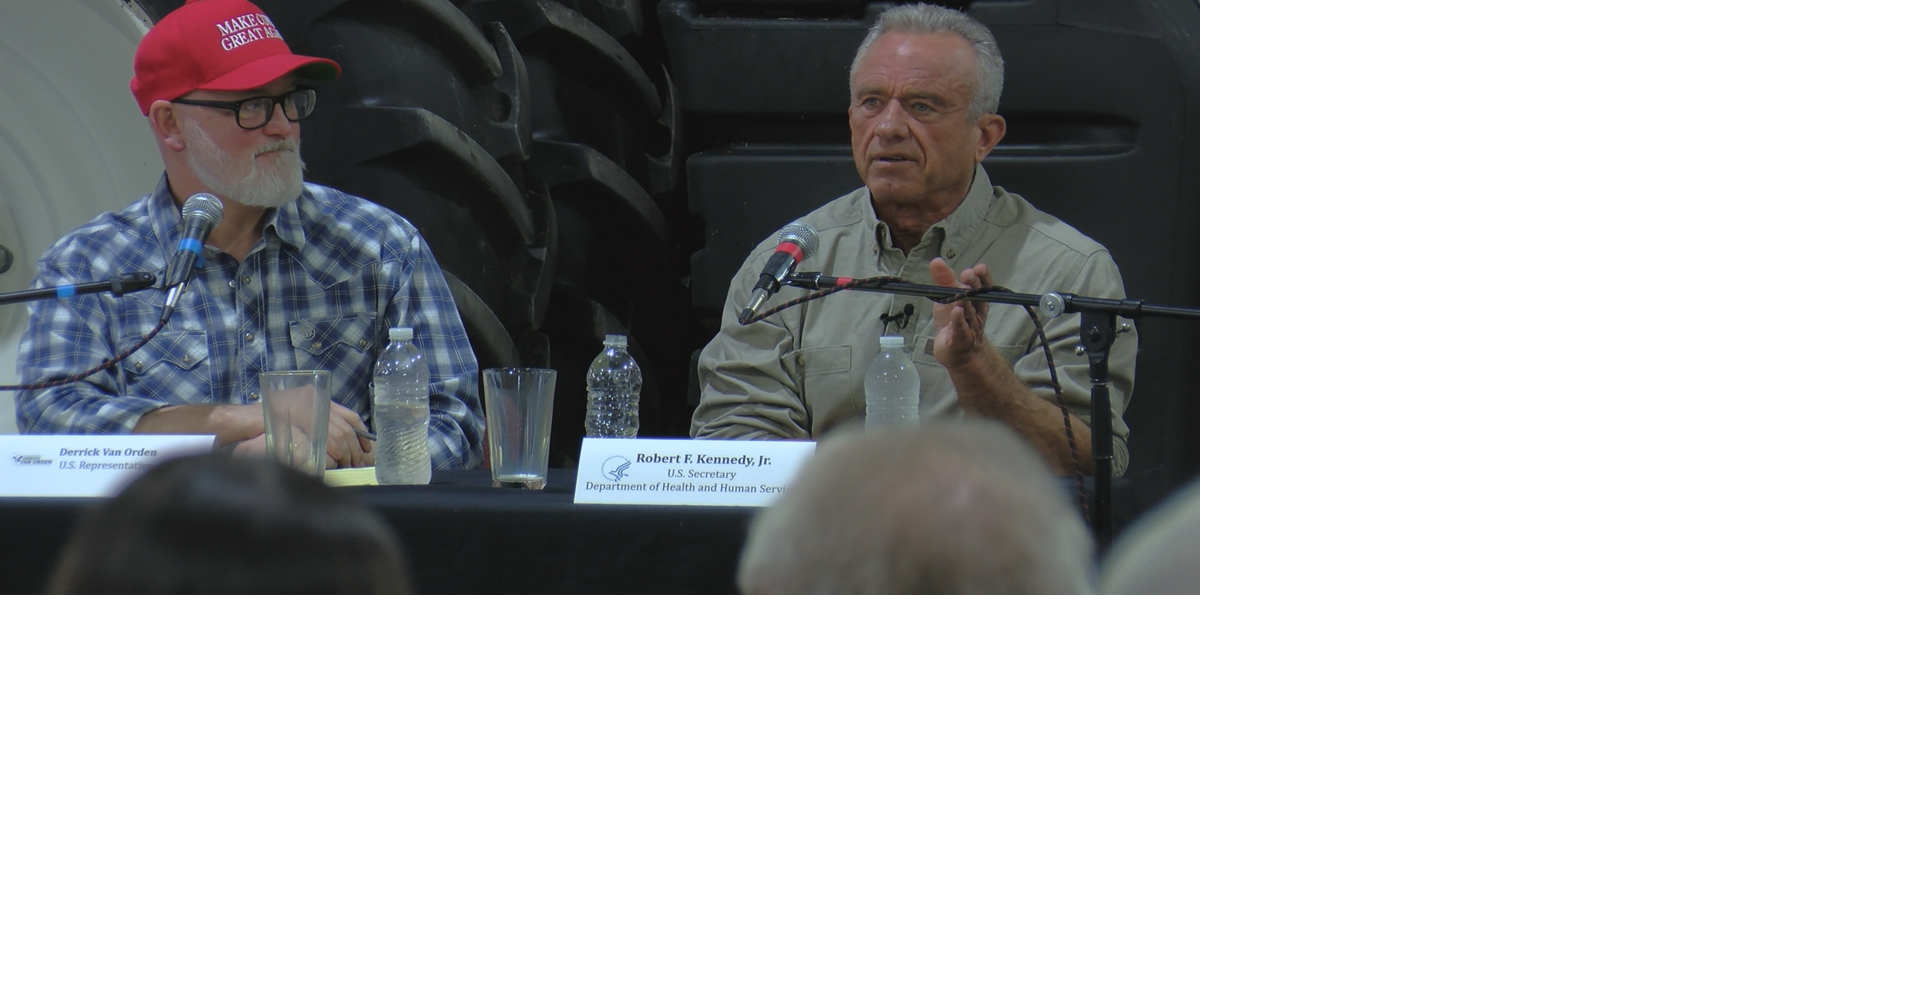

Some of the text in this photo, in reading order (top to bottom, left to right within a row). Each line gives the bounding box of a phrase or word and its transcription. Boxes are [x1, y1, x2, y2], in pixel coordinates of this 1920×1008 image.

[216, 13, 257, 37] MAKE
[221, 27, 265, 51] GREAT
[59, 447, 157, 457] Derrick Van Orden
[59, 460, 76, 469] U.S.
[636, 453, 772, 468] Robert F. Kennedy, Jr.
[667, 468, 737, 481] U.S. Secretary
[585, 481, 647, 493] Department
[649, 481, 661, 491] of
[662, 482, 696, 492] Health
[697, 483, 718, 492] and
[720, 483, 757, 493] Human
